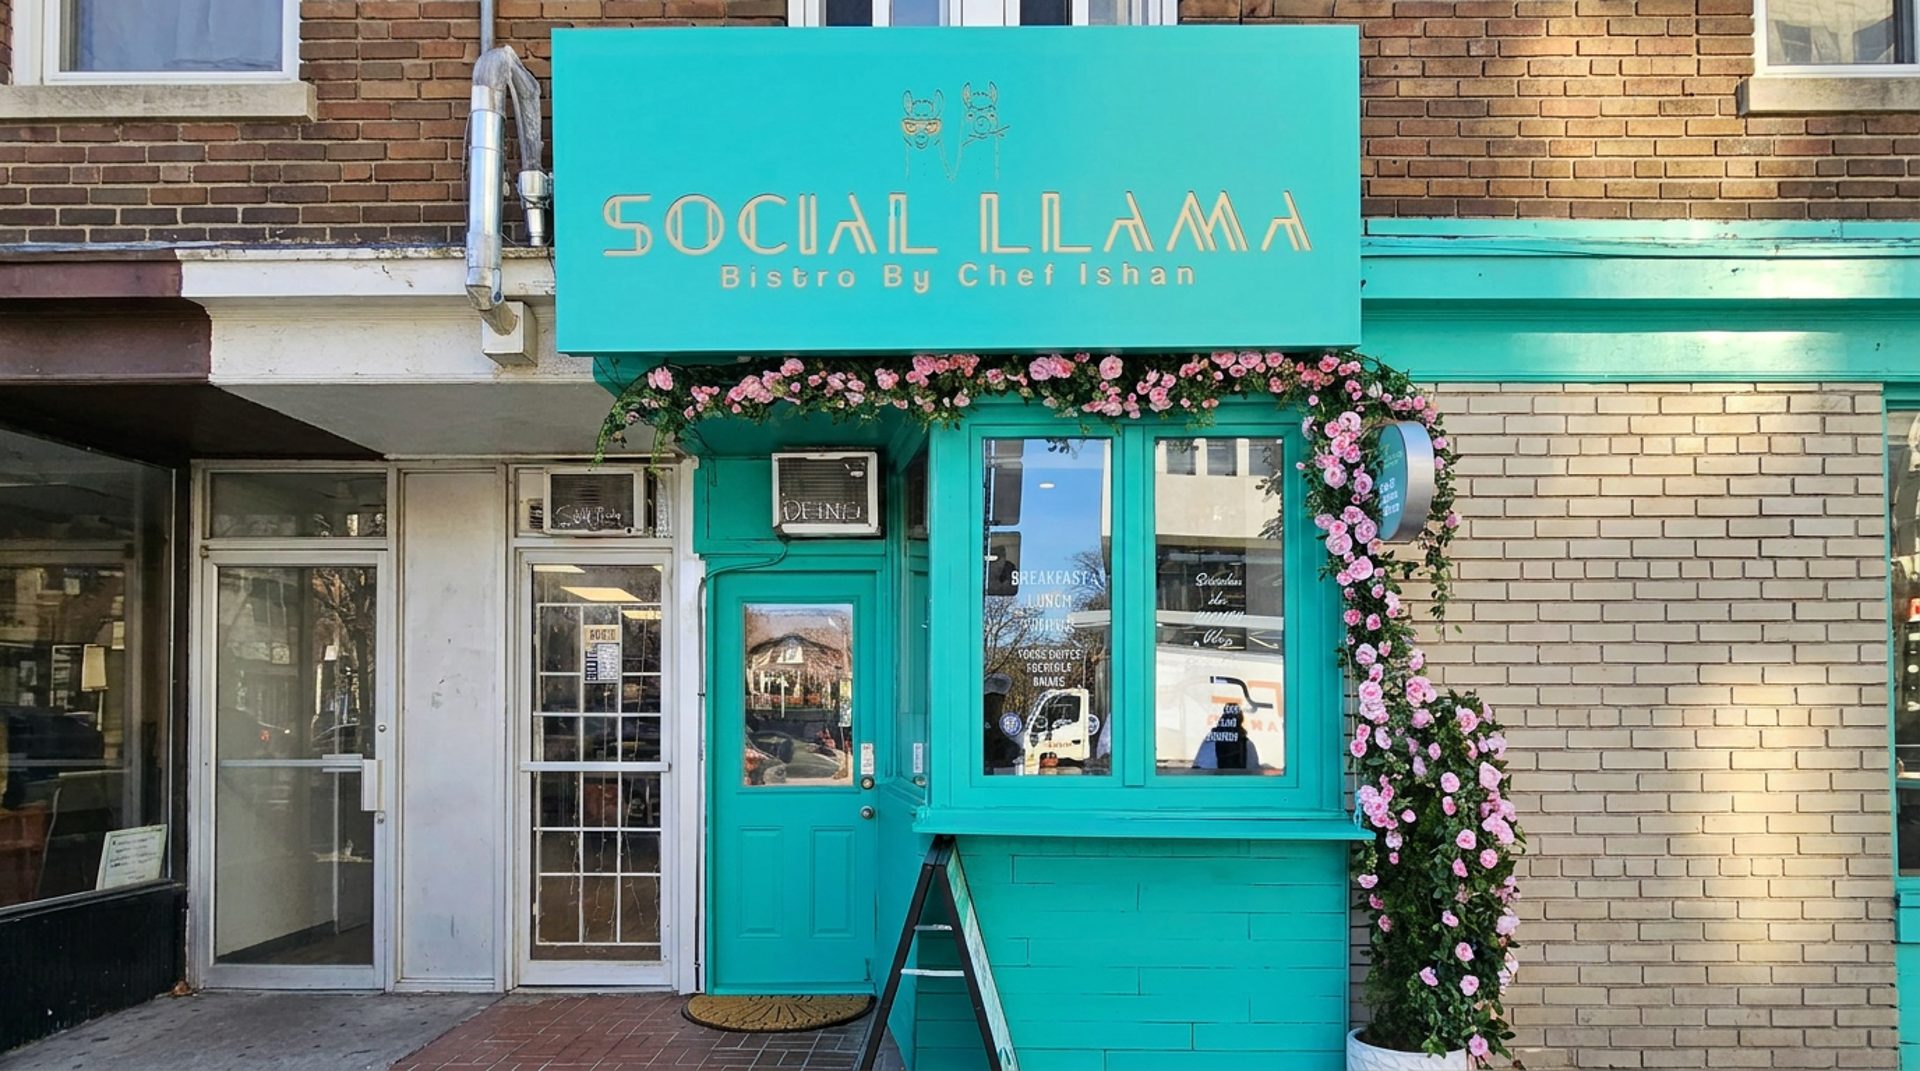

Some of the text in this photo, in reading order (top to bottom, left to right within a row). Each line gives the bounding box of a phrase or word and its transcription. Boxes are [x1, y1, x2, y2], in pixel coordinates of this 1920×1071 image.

[602, 189, 1312, 258] SOCIAL LLAMA
[720, 262, 1195, 294] Bistro By Chef Ishan
